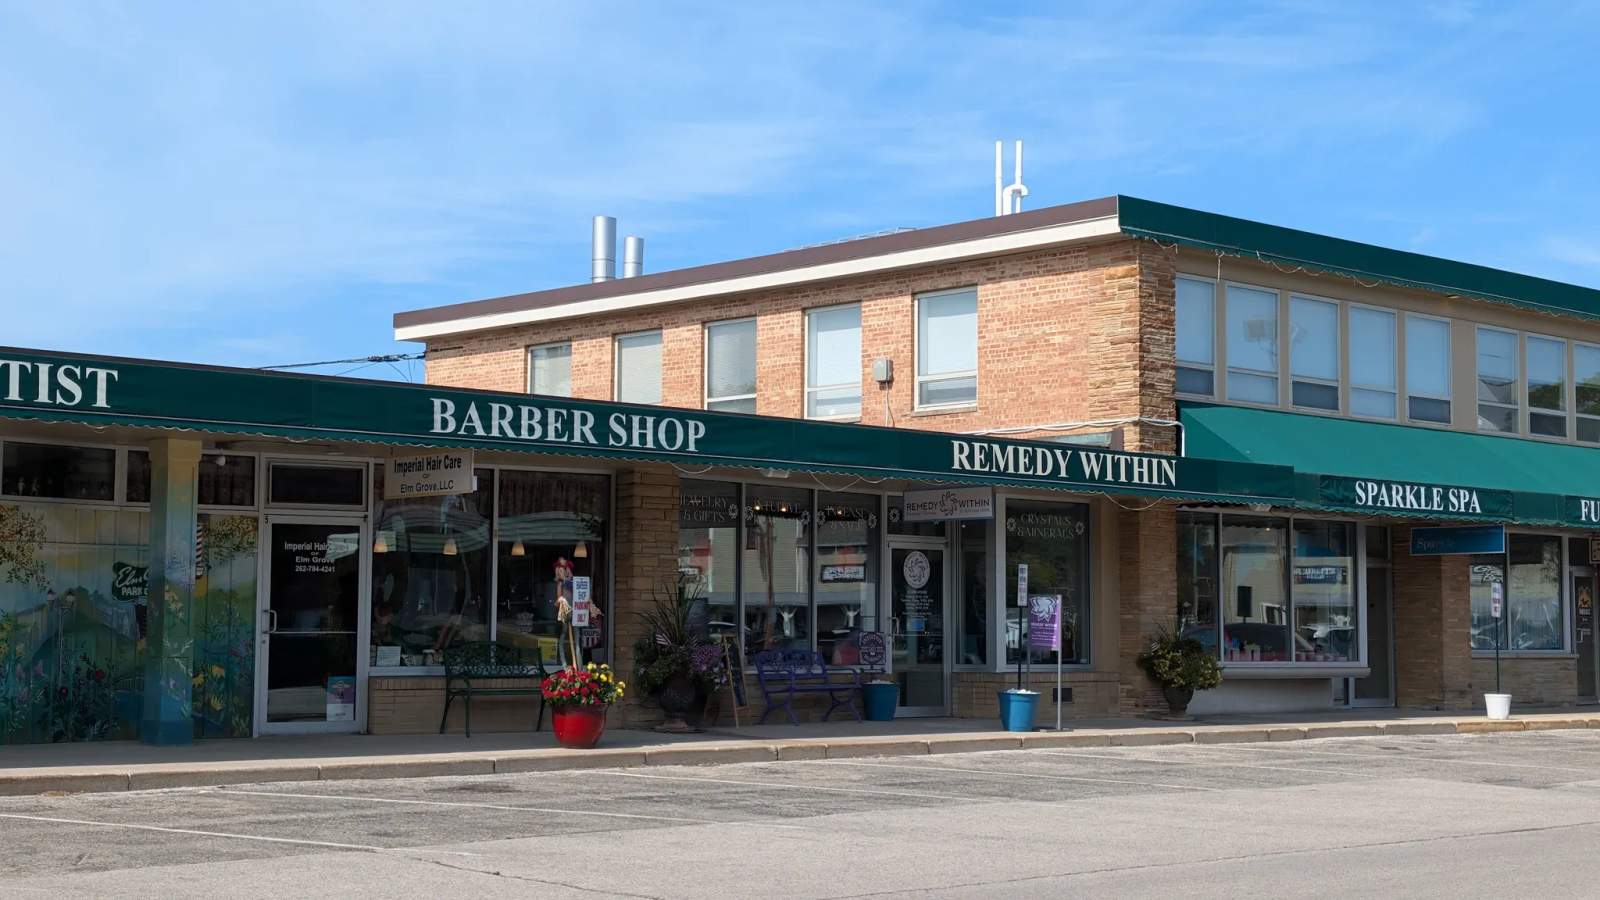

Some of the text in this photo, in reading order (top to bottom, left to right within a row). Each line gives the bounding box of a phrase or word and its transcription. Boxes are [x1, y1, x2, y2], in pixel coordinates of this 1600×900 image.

[0, 359, 119, 408] TIST
[430, 397, 706, 452] BARBER SHOP
[394, 454, 462, 477] Imperial Hair Care
[951, 440, 1177, 487] REMEDY WITHIN
[400, 484, 414, 493] Elm
[1355, 480, 1482, 513] SPARKLE SPA
[906, 498, 990, 512] REMEDY WITHIN
[284, 541, 313, 552] Imperial
